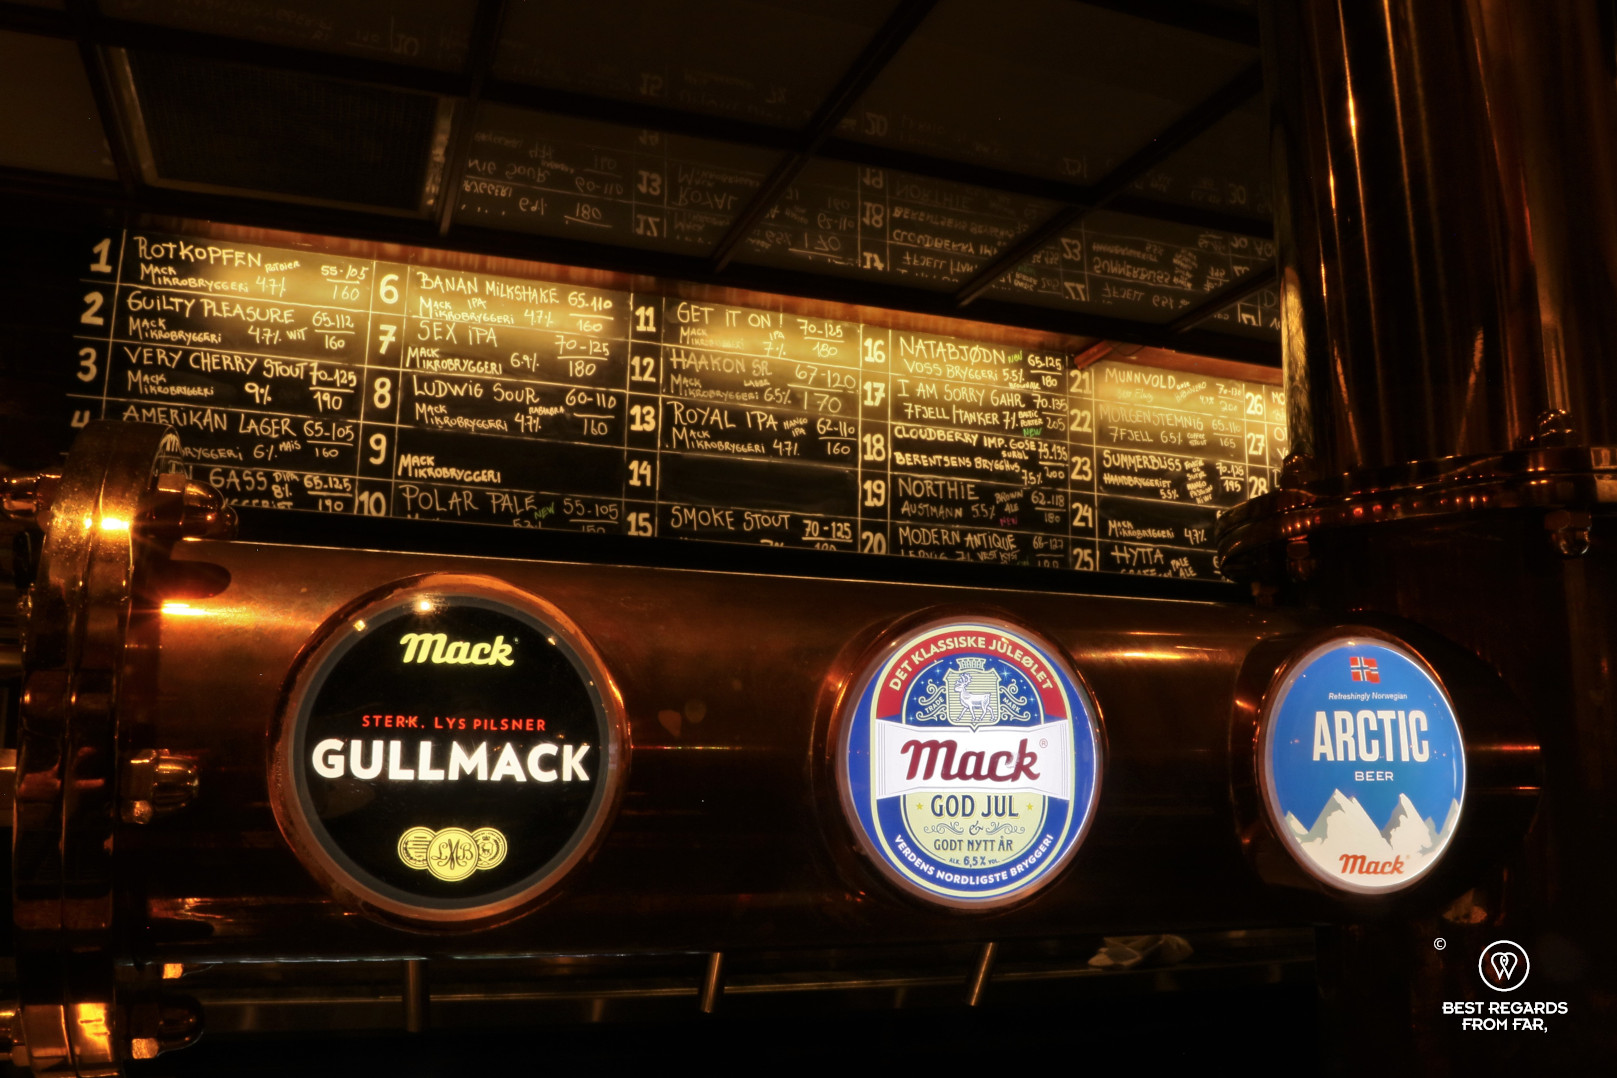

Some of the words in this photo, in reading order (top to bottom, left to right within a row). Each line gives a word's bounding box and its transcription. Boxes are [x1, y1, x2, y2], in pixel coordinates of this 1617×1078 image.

[90, 237, 113, 273] 1
[133, 236, 261, 267] ROTKOPFEN
[332, 285, 360, 301] 160
[379, 274, 399, 305] 6
[416, 271, 479, 295] BANAN
[80, 291, 104, 325] 2
[200, 298, 295, 324] PLEASURE
[634, 305, 657, 333] 11
[677, 301, 715, 325] GET
[417, 320, 458, 345] SEX
[577, 319, 603, 333] 160
[325, 334, 346, 350] 160
[378, 324, 398, 354] 7
[812, 341, 838, 358] 180
[863, 338, 886, 363] 16
[76, 346, 98, 382] 3
[123, 346, 182, 368] VERY
[189, 351, 257, 375] CHERRY
[263, 359, 308, 379] STOUT
[569, 360, 597, 378] 180
[630, 356, 656, 382] 12
[670, 348, 746, 374] HAAKON
[903, 358, 942, 377] VOSS
[373, 377, 392, 409] 8
[492, 383, 540, 405] SOUR
[862, 381, 886, 407] 17
[897, 379, 910, 397] I
[915, 382, 938, 399] AM
[944, 383, 985, 406] SORRY
[990, 389, 1026, 408] GAHR
[1041, 375, 1058, 388] 180
[1069, 369, 1092, 394] 21
[803, 391, 842, 413] 170
[1245, 392, 1264, 416] 26
[238, 413, 297, 438] LAGER
[584, 418, 608, 436] 160
[629, 404, 656, 432] 13
[666, 400, 737, 430] ROYAL
[746, 411, 778, 431] IPA
[1069, 408, 1092, 433] 22
[369, 433, 387, 465] 9
[827, 442, 851, 456] 160
[862, 433, 886, 461] 18
[894, 425, 979, 447] CLOUDBERRY
[1009, 439, 1037, 451] GOSE
[1247, 432, 1265, 456] 27
[315, 447, 339, 458] 160
[397, 453, 435, 476] MACK
[893, 451, 972, 468] BERENTSENS
[628, 460, 652, 486] 14
[1070, 456, 1093, 481] 23
[863, 480, 886, 507] 19
[1248, 476, 1268, 499] 28
[358, 490, 387, 517] 10
[398, 485, 479, 516] POLAR
[485, 490, 538, 516] PALE
[626, 512, 653, 537] 15
[671, 505, 735, 531] SMOKE
[743, 511, 791, 531] STOUT
[1071, 502, 1093, 528] 24
[861, 531, 887, 554] 20
[898, 526, 961, 546] MODERN
[1073, 547, 1094, 570] 25
[1111, 545, 1164, 566] HYTTA
[400, 633, 515, 666] Mack
[889, 658, 911, 691] DET
[911, 635, 986, 665] KLASSISKE
[988, 639, 1053, 691] JULEØLET
[925, 696, 945, 714] TRADE
[1002, 697, 1021, 714] MARK
[1328, 692, 1370, 701] Refreshingly
[1372, 692, 1408, 702] Norwegian
[434, 716, 467, 730] LYS
[473, 718, 547, 731] PILSNER
[1312, 709, 1430, 762] ARCTIC
[312, 738, 591, 783] GULLMACK
[900, 738, 1040, 783] Mack
[1354, 770, 1394, 782] BEER
[930, 794, 976, 818] GOD
[981, 794, 1020, 818] JUL
[933, 838, 964, 852] GODT
[967, 838, 996, 852] NYTT
[998, 835, 1014, 852] ÅR
[894, 833, 936, 876] VERDENS
[936, 869, 1008, 885] NORDLIGSTE
[1010, 833, 1054, 877] BRYGGERI
[1339, 853, 1405, 875] Mack
